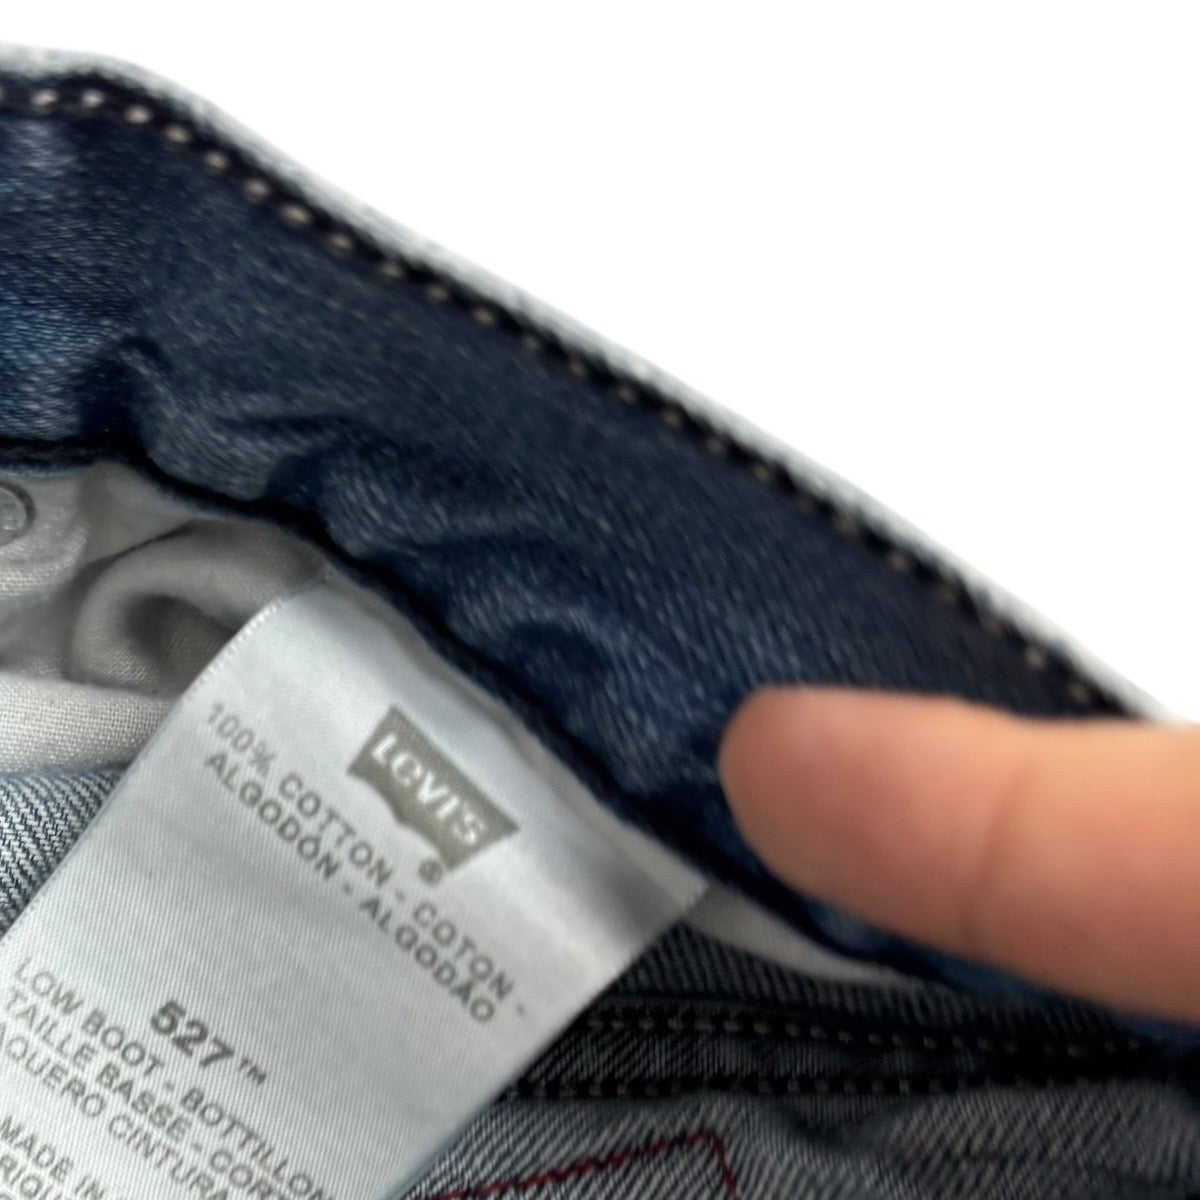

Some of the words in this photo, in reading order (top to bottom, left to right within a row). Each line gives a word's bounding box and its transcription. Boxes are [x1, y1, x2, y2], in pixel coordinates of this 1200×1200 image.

[207, 703, 277, 777] 100%
[278, 772, 394, 888] COTTON
[412, 902, 515, 1002] COTON
[3, 986, 97, 1066] TAILLE
[98, 1064, 191, 1141] BASSE
[13, 956, 84, 1015] LOW
[81, 1008, 165, 1077] BOOT
